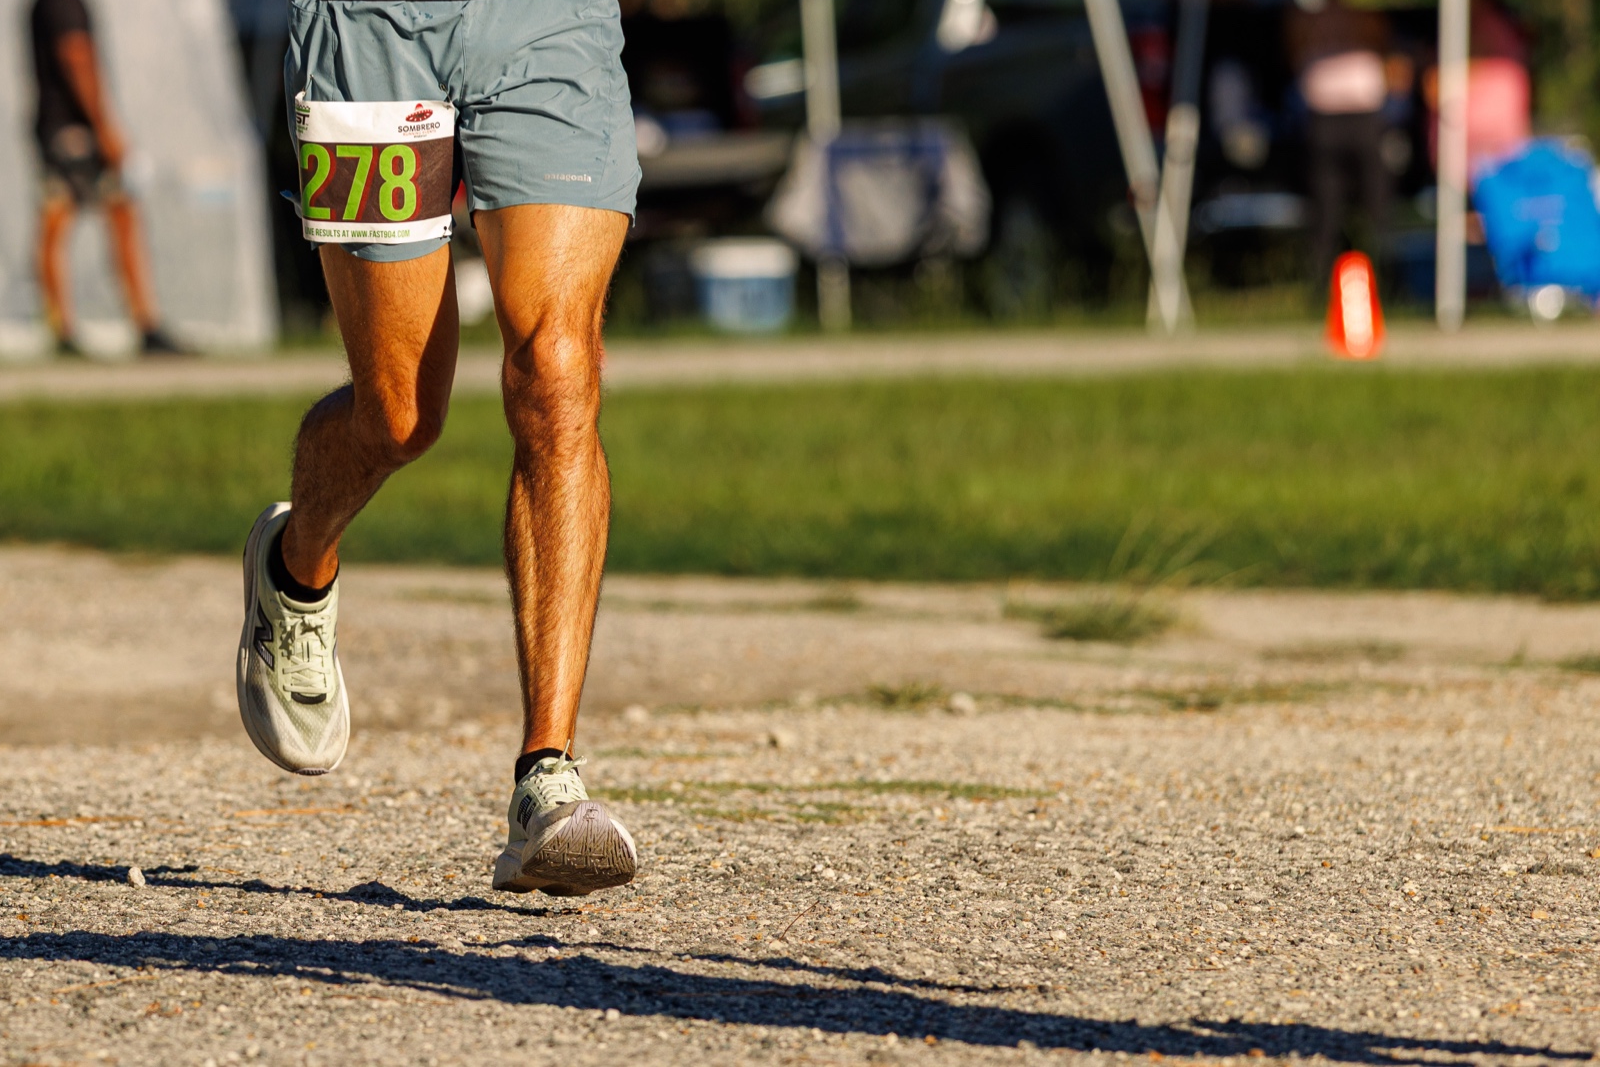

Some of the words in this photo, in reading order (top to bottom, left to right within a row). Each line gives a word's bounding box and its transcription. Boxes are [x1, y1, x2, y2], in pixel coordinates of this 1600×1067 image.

[398, 121, 441, 133] SOMBRERO
[301, 143, 419, 222] 278
[543, 173, 592, 183] patagonia
[316, 228, 340, 238] RESULTS
[342, 230, 349, 238] AT
[351, 229, 411, 239] WWW.FAST904.COM
